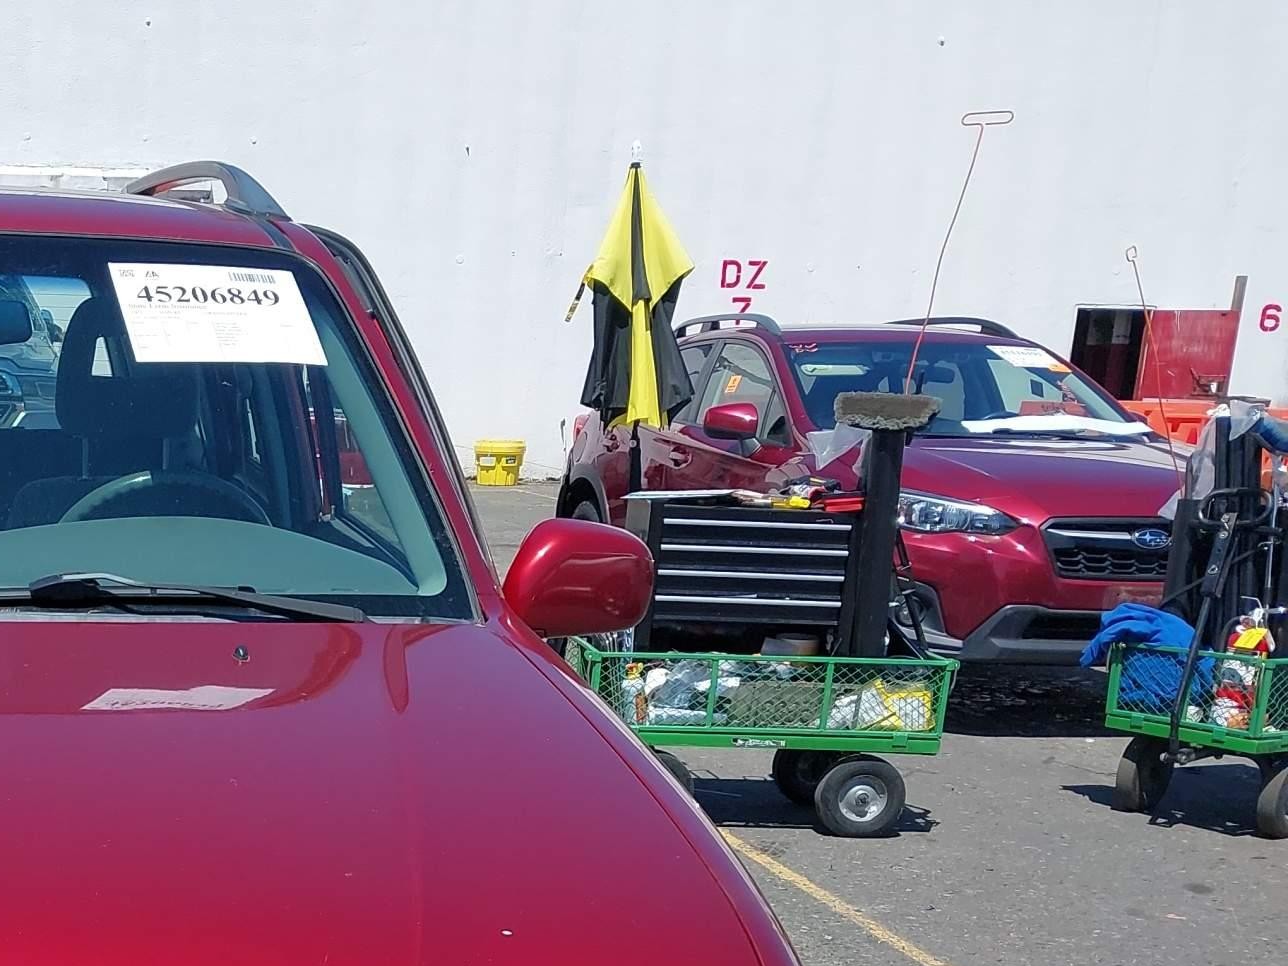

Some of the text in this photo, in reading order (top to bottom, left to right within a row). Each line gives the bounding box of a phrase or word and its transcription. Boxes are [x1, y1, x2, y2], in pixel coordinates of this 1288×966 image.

[720, 259, 769, 290] DZ
[136, 285, 280, 307] 45206849
[1259, 303, 1283, 333] 6
